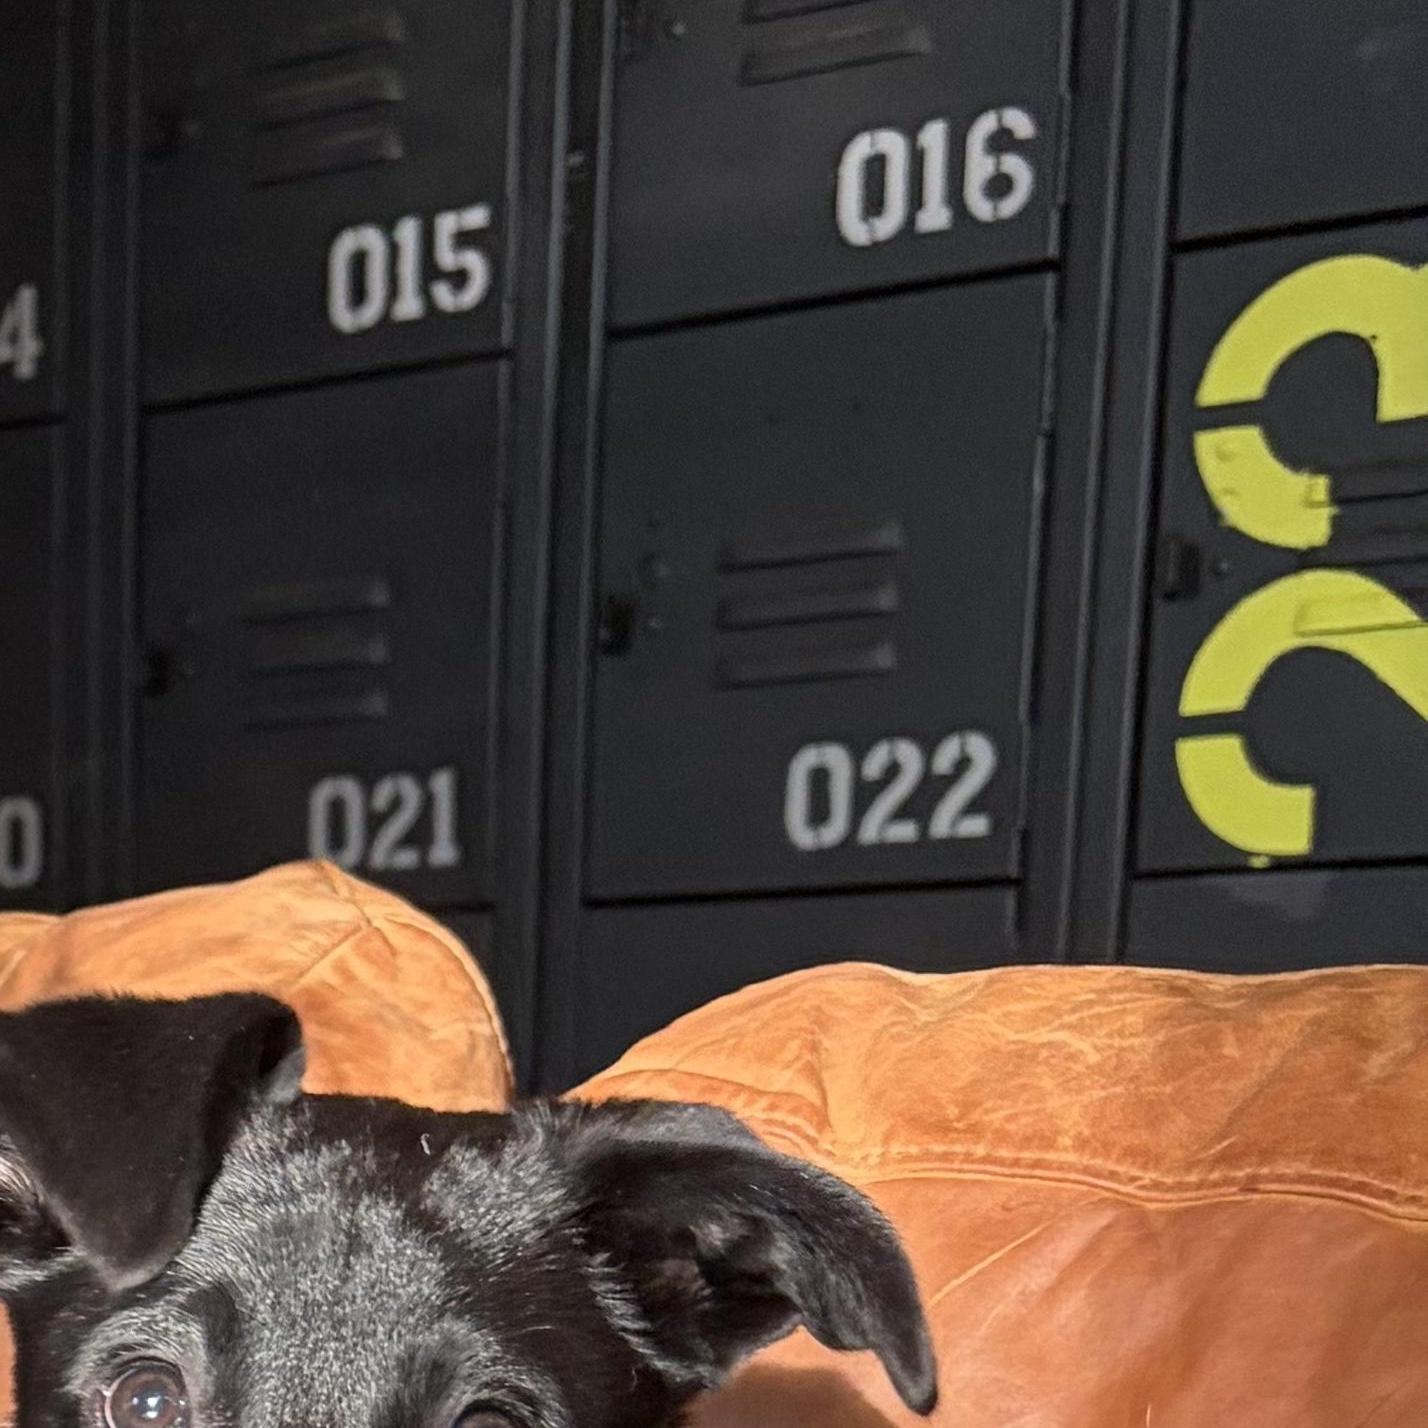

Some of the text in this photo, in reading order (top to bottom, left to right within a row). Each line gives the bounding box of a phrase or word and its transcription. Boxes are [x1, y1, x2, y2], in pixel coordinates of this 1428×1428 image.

[836, 107, 1036, 247] 016
[328, 203, 491, 333] 015
[307, 769, 460, 870] 021
[784, 731, 998, 851] 022
